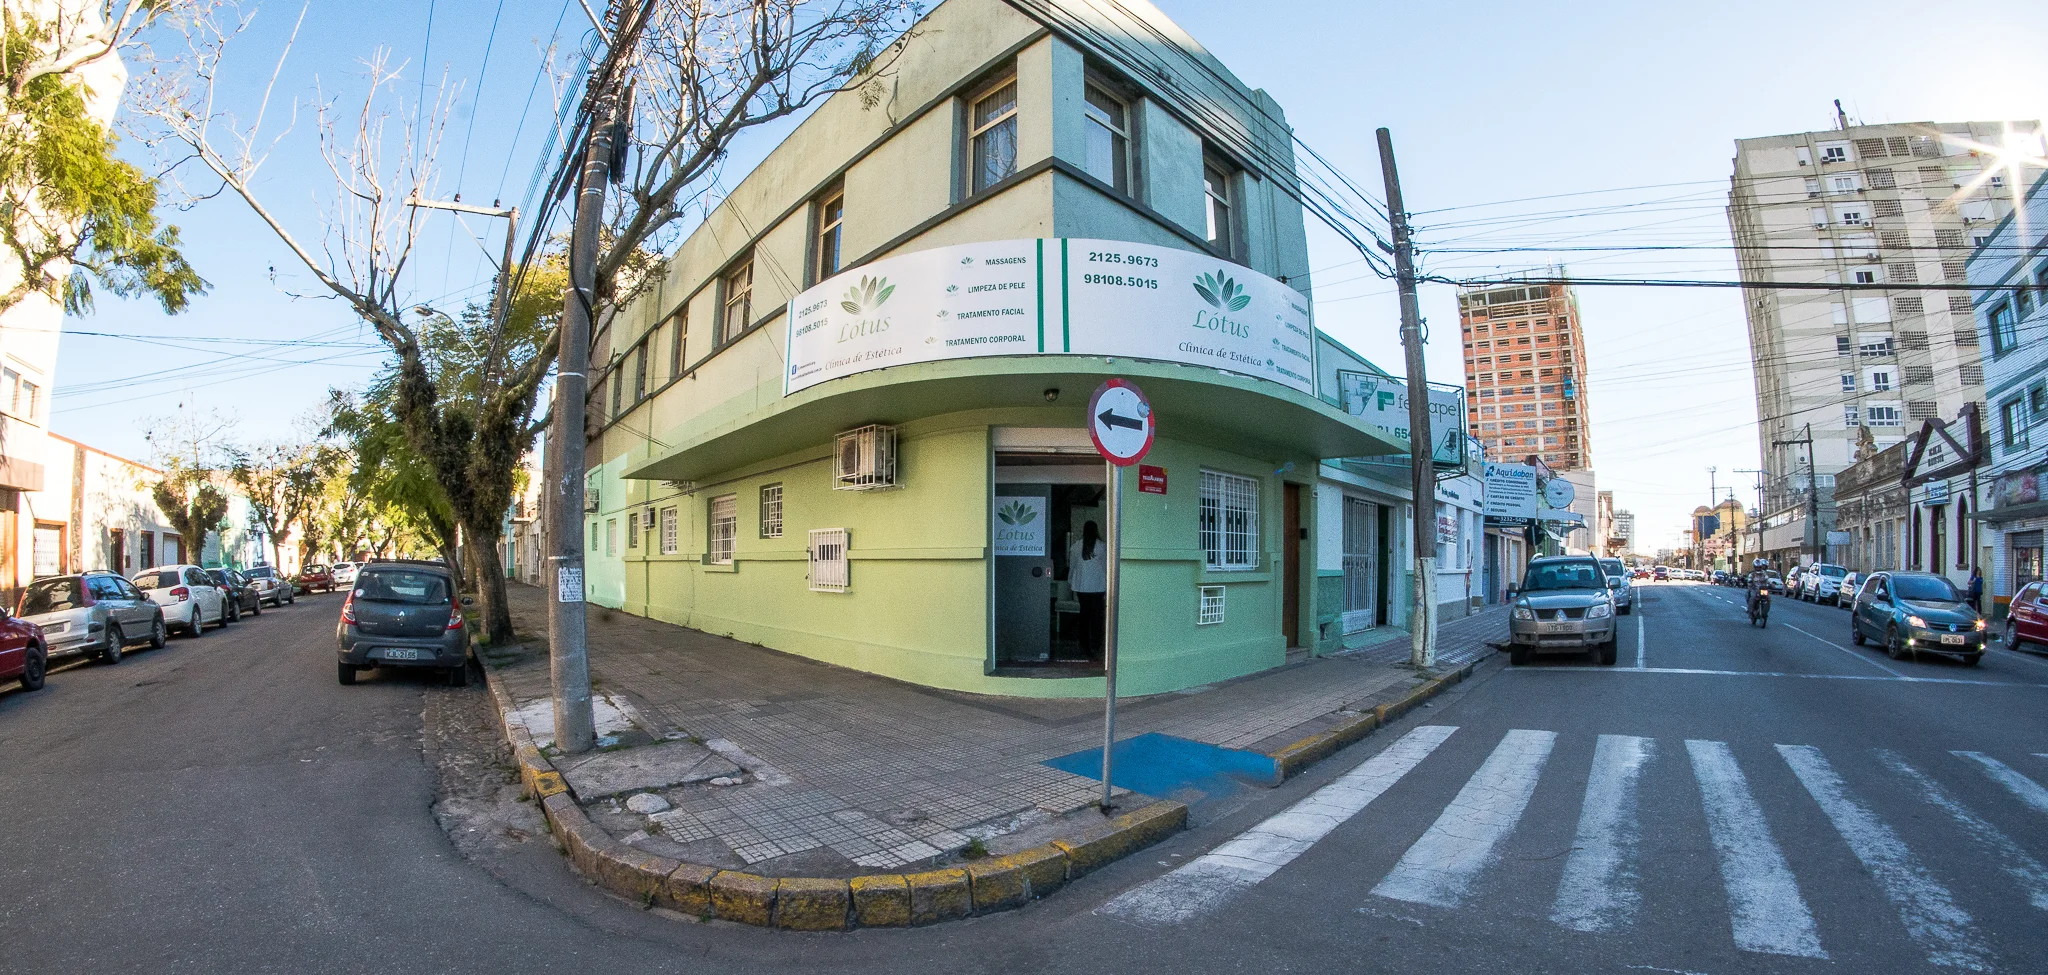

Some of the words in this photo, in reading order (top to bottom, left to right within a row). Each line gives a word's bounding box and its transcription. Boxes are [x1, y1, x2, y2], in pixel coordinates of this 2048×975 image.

[985, 256, 1027, 266] MASSAGENS
[1089, 251, 1159, 268] 2125.9673
[967, 284, 997, 294] LIMPEZA
[998, 283, 1008, 291] DE
[1009, 282, 1026, 290] PELE
[1084, 273, 1159, 290] 98108.5015
[798, 299, 828, 319] 2125.9673
[957, 309, 1000, 320] TRATAMENTO
[1001, 308, 1025, 317] FACIAL
[795, 317, 828, 338] 98108.5015
[837, 316, 891, 344] Lótus
[1192, 309, 1250, 339] Lótus
[945, 336, 988, 347] TRATAMENTO
[989, 335, 1026, 344] CORPORAL
[852, 351, 863, 363] de
[865, 346, 902, 361] Estética
[1216, 348, 1227, 359] de
[1229, 351, 1262, 367] Estética
[997, 528, 1035, 541] Lótus
